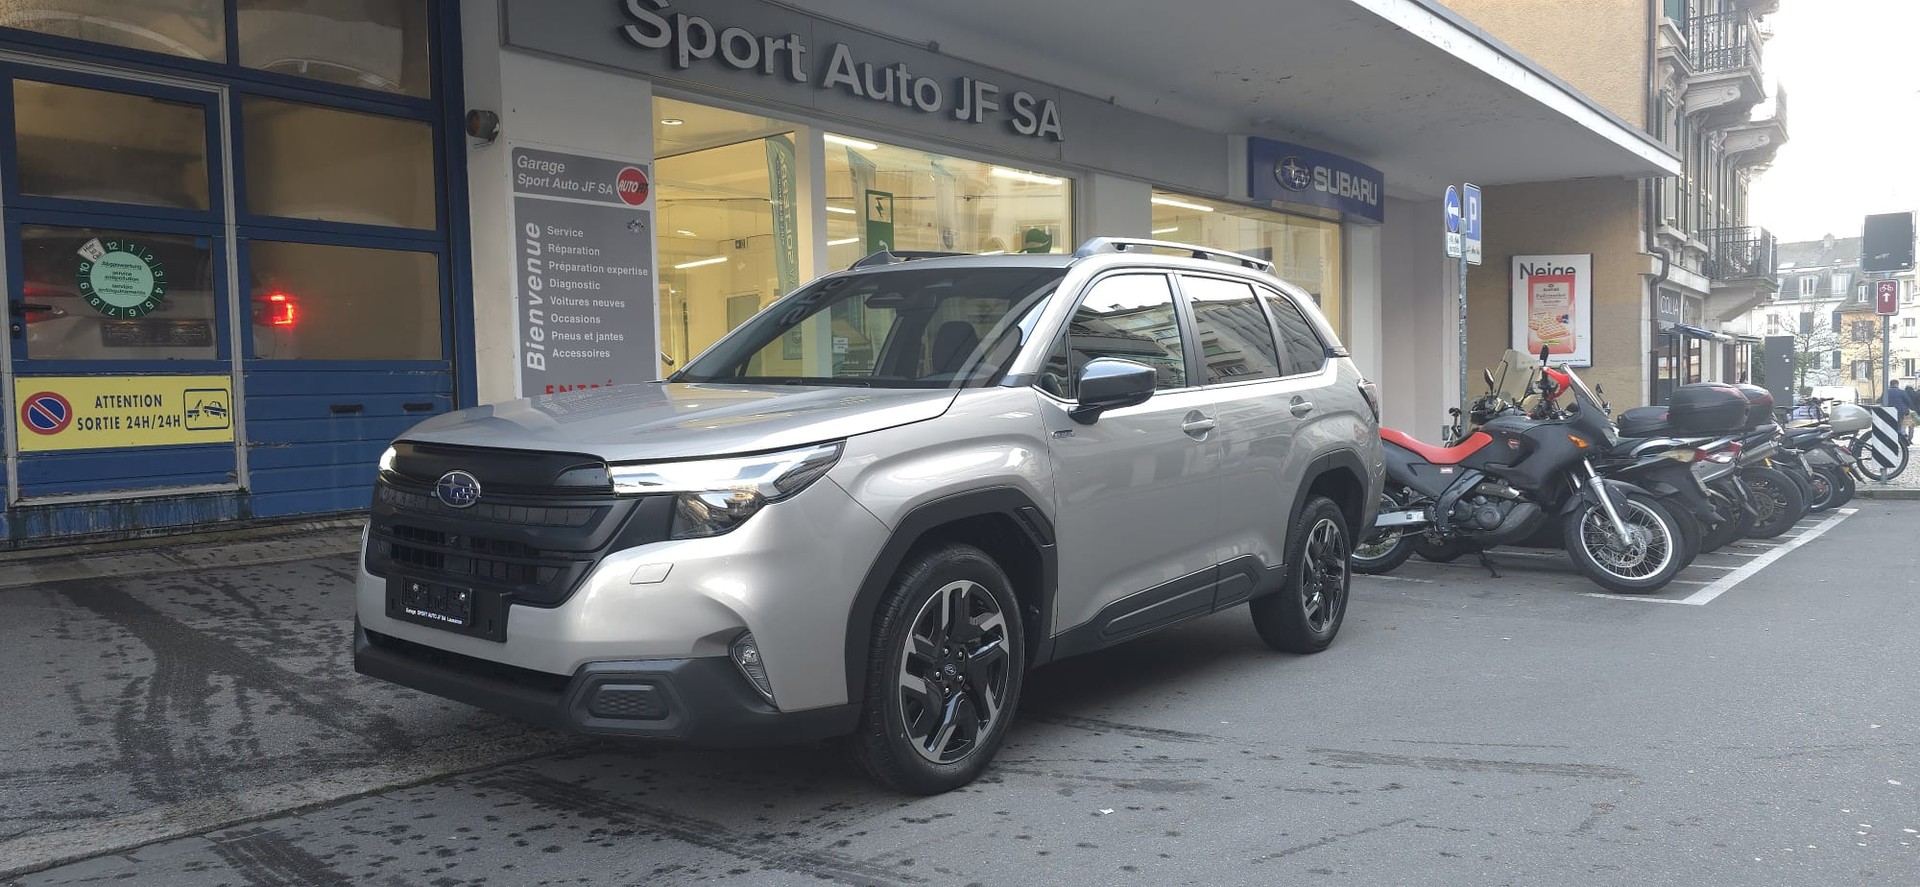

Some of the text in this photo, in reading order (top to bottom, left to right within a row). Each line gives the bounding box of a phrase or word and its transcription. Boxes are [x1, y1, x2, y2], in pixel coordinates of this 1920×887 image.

[623, 0, 1064, 141] Sport Auto JF SA
[517, 155, 565, 175] Garage
[518, 173, 613, 195] Sport Auto JF SA
[1313, 166, 1377, 206] SUBARU
[547, 225, 584, 237] Service
[106, 241, 119, 251] 12
[129, 244, 135, 252] 1
[548, 243, 600, 256] Réparation
[144, 254, 154, 263] 2
[79, 262, 90, 272] 10
[549, 261, 648, 276] Préparation expertise
[549, 278, 600, 291] Diagnostic
[90, 298, 100, 306] 8
[525, 222, 546, 371] Bienvenue
[550, 296, 625, 308] Voitures neuves
[145, 301, 154, 309] 5
[108, 307, 116, 316] 7
[551, 313, 601, 324] Occasions
[551, 331, 624, 342] Pneus et jantes
[552, 348, 610, 358] Accessoires
[95, 394, 162, 409] ATTENTION
[77, 414, 180, 430] SORTIE 24H/24H
